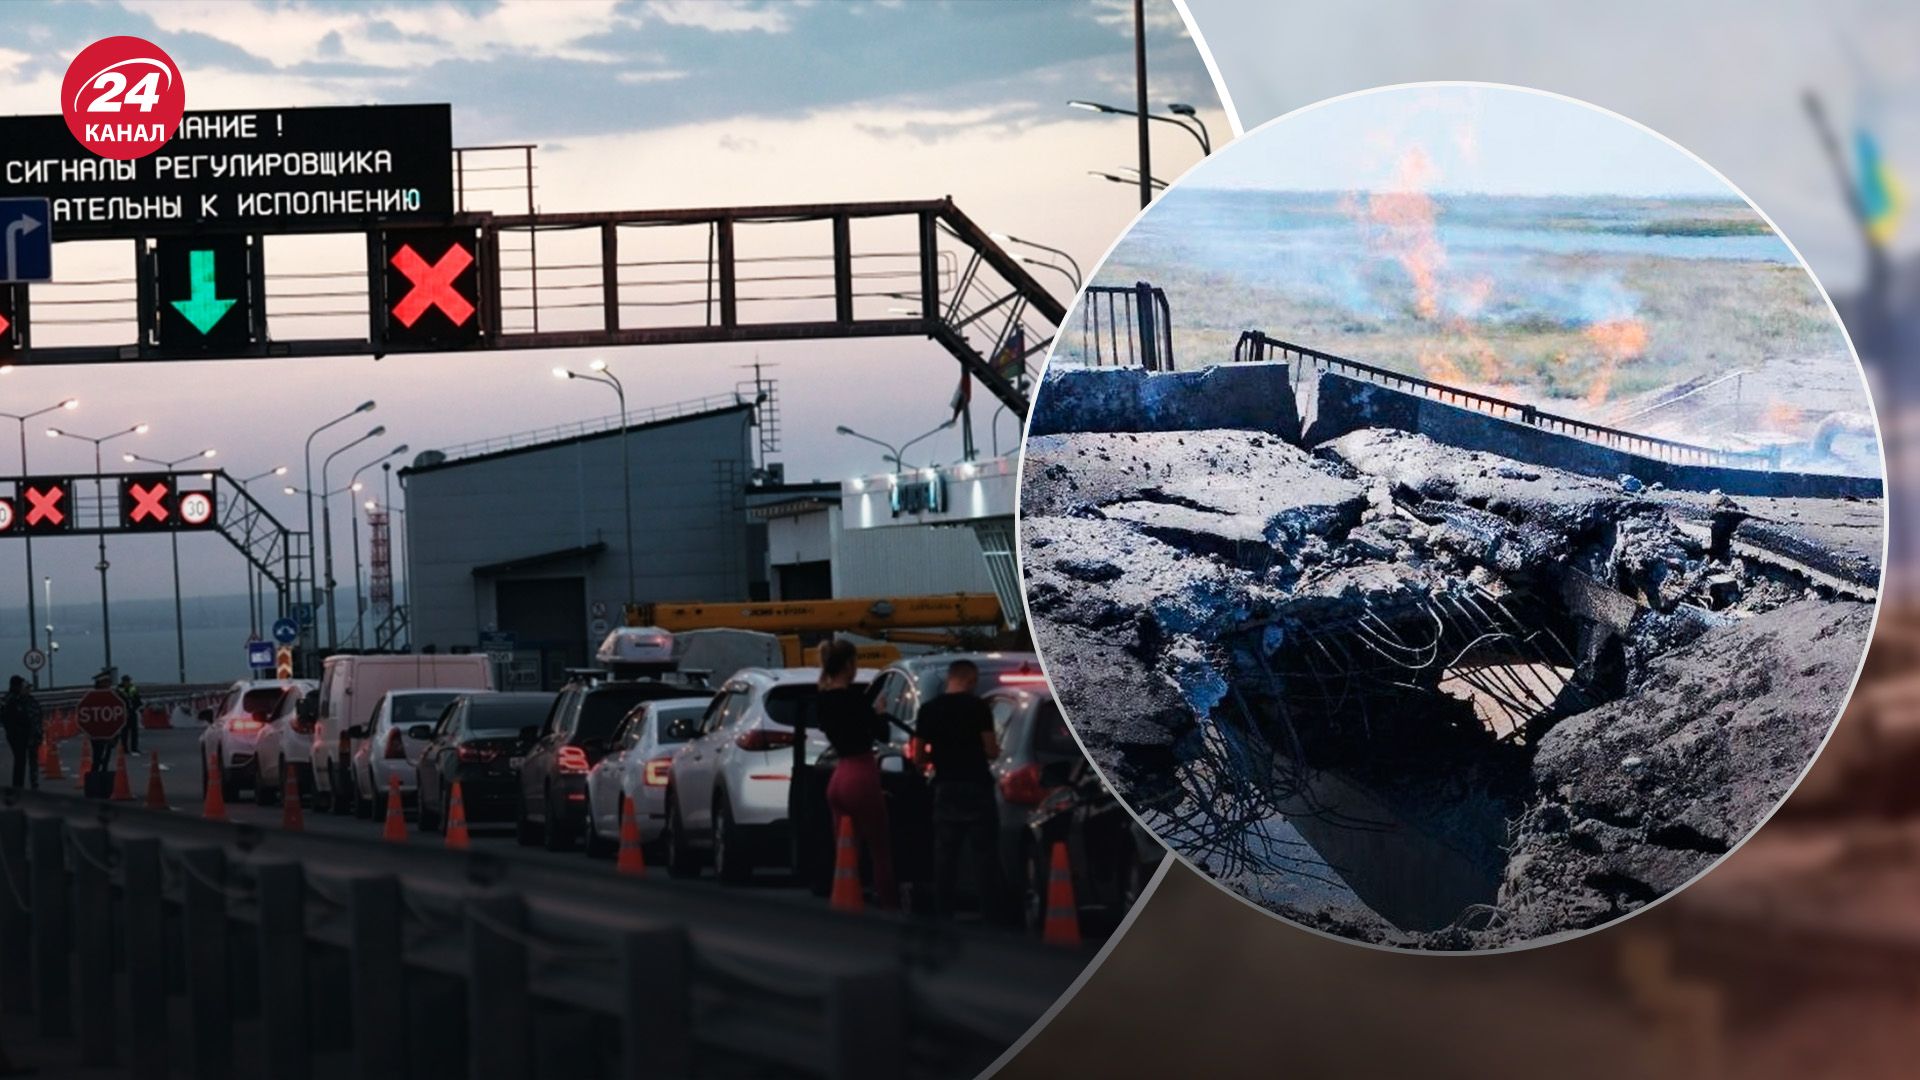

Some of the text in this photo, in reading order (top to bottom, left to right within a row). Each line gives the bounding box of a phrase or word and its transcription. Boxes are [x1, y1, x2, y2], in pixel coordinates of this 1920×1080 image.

[276, 114, 283, 136] !
[6, 150, 392, 184] СИГНАЛЫ РЕГУЛИРОВЩИКА
[53, 188, 421, 222] АТЕЛЬНЫ К ИСПОЛНЕНИЮ
[187, 500, 205, 516] 30
[80, 706, 123, 722] STOP
